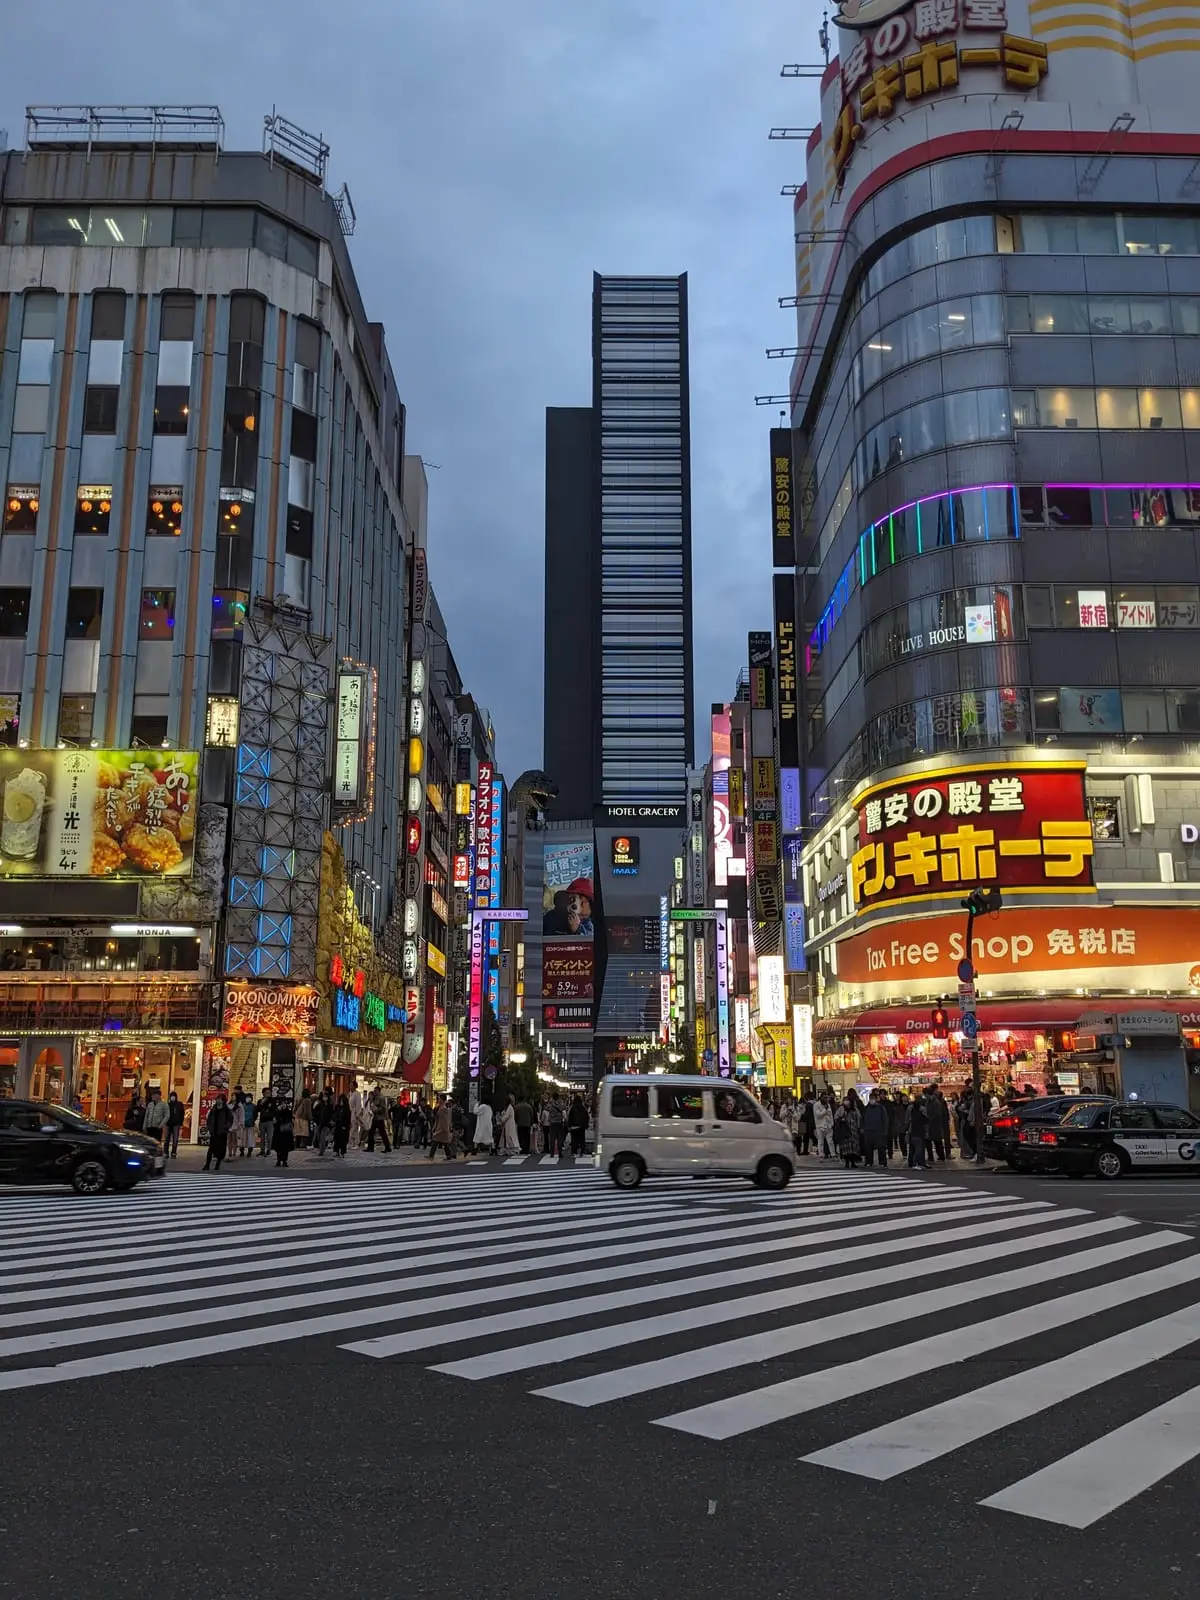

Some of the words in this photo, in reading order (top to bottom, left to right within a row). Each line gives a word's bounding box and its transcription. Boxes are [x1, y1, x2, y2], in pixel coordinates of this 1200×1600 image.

[776, 457, 791, 537] 驚安の殿堂
[1080, 604, 1107, 627] 新宿
[1119, 604, 1154, 625] アイドル
[1161, 605, 1196, 625] ステージ
[901, 634, 923, 653] LIVE
[929, 626, 965, 645] HOUSE
[216, 727, 230, 742] 光
[758, 760, 767, 789] 生ビール
[126, 762, 146, 813] チキンが
[342, 781, 351, 791] 光
[145, 786, 168, 836] 猛烈に
[608, 807, 637, 816] HOTEL
[638, 807, 680, 816] GRACERY
[758, 811, 773, 821] 4F
[866, 778, 1025, 834] 驚安の殿堂
[63, 811, 80, 830] 光
[477, 766, 491, 871] カラオケ歌広場
[756, 823, 773, 852] 麻雀
[1181, 824, 1198, 843] D
[59, 856, 77, 870] 4F
[546, 857, 578, 872] 新宿で
[612, 867, 638, 875] IMAX
[549, 866, 593, 886] 大ピンチ
[756, 869, 778, 918] CASINO
[1047, 928, 1136, 956] 免税店
[544, 959, 593, 970] パディントン
[866, 947, 887, 972] Tax
[891, 939, 939, 967] Free
[557, 981, 571, 991] 5.9
[227, 991, 320, 1009] OKONOMIYAKI
[231, 1006, 311, 1026] お好み焼き
[406, 990, 418, 1034] トラノコ
[558, 1007, 591, 1017] MARUHAN
[906, 1019, 930, 1029] Don
[470, 1016, 480, 1053] ROAD
